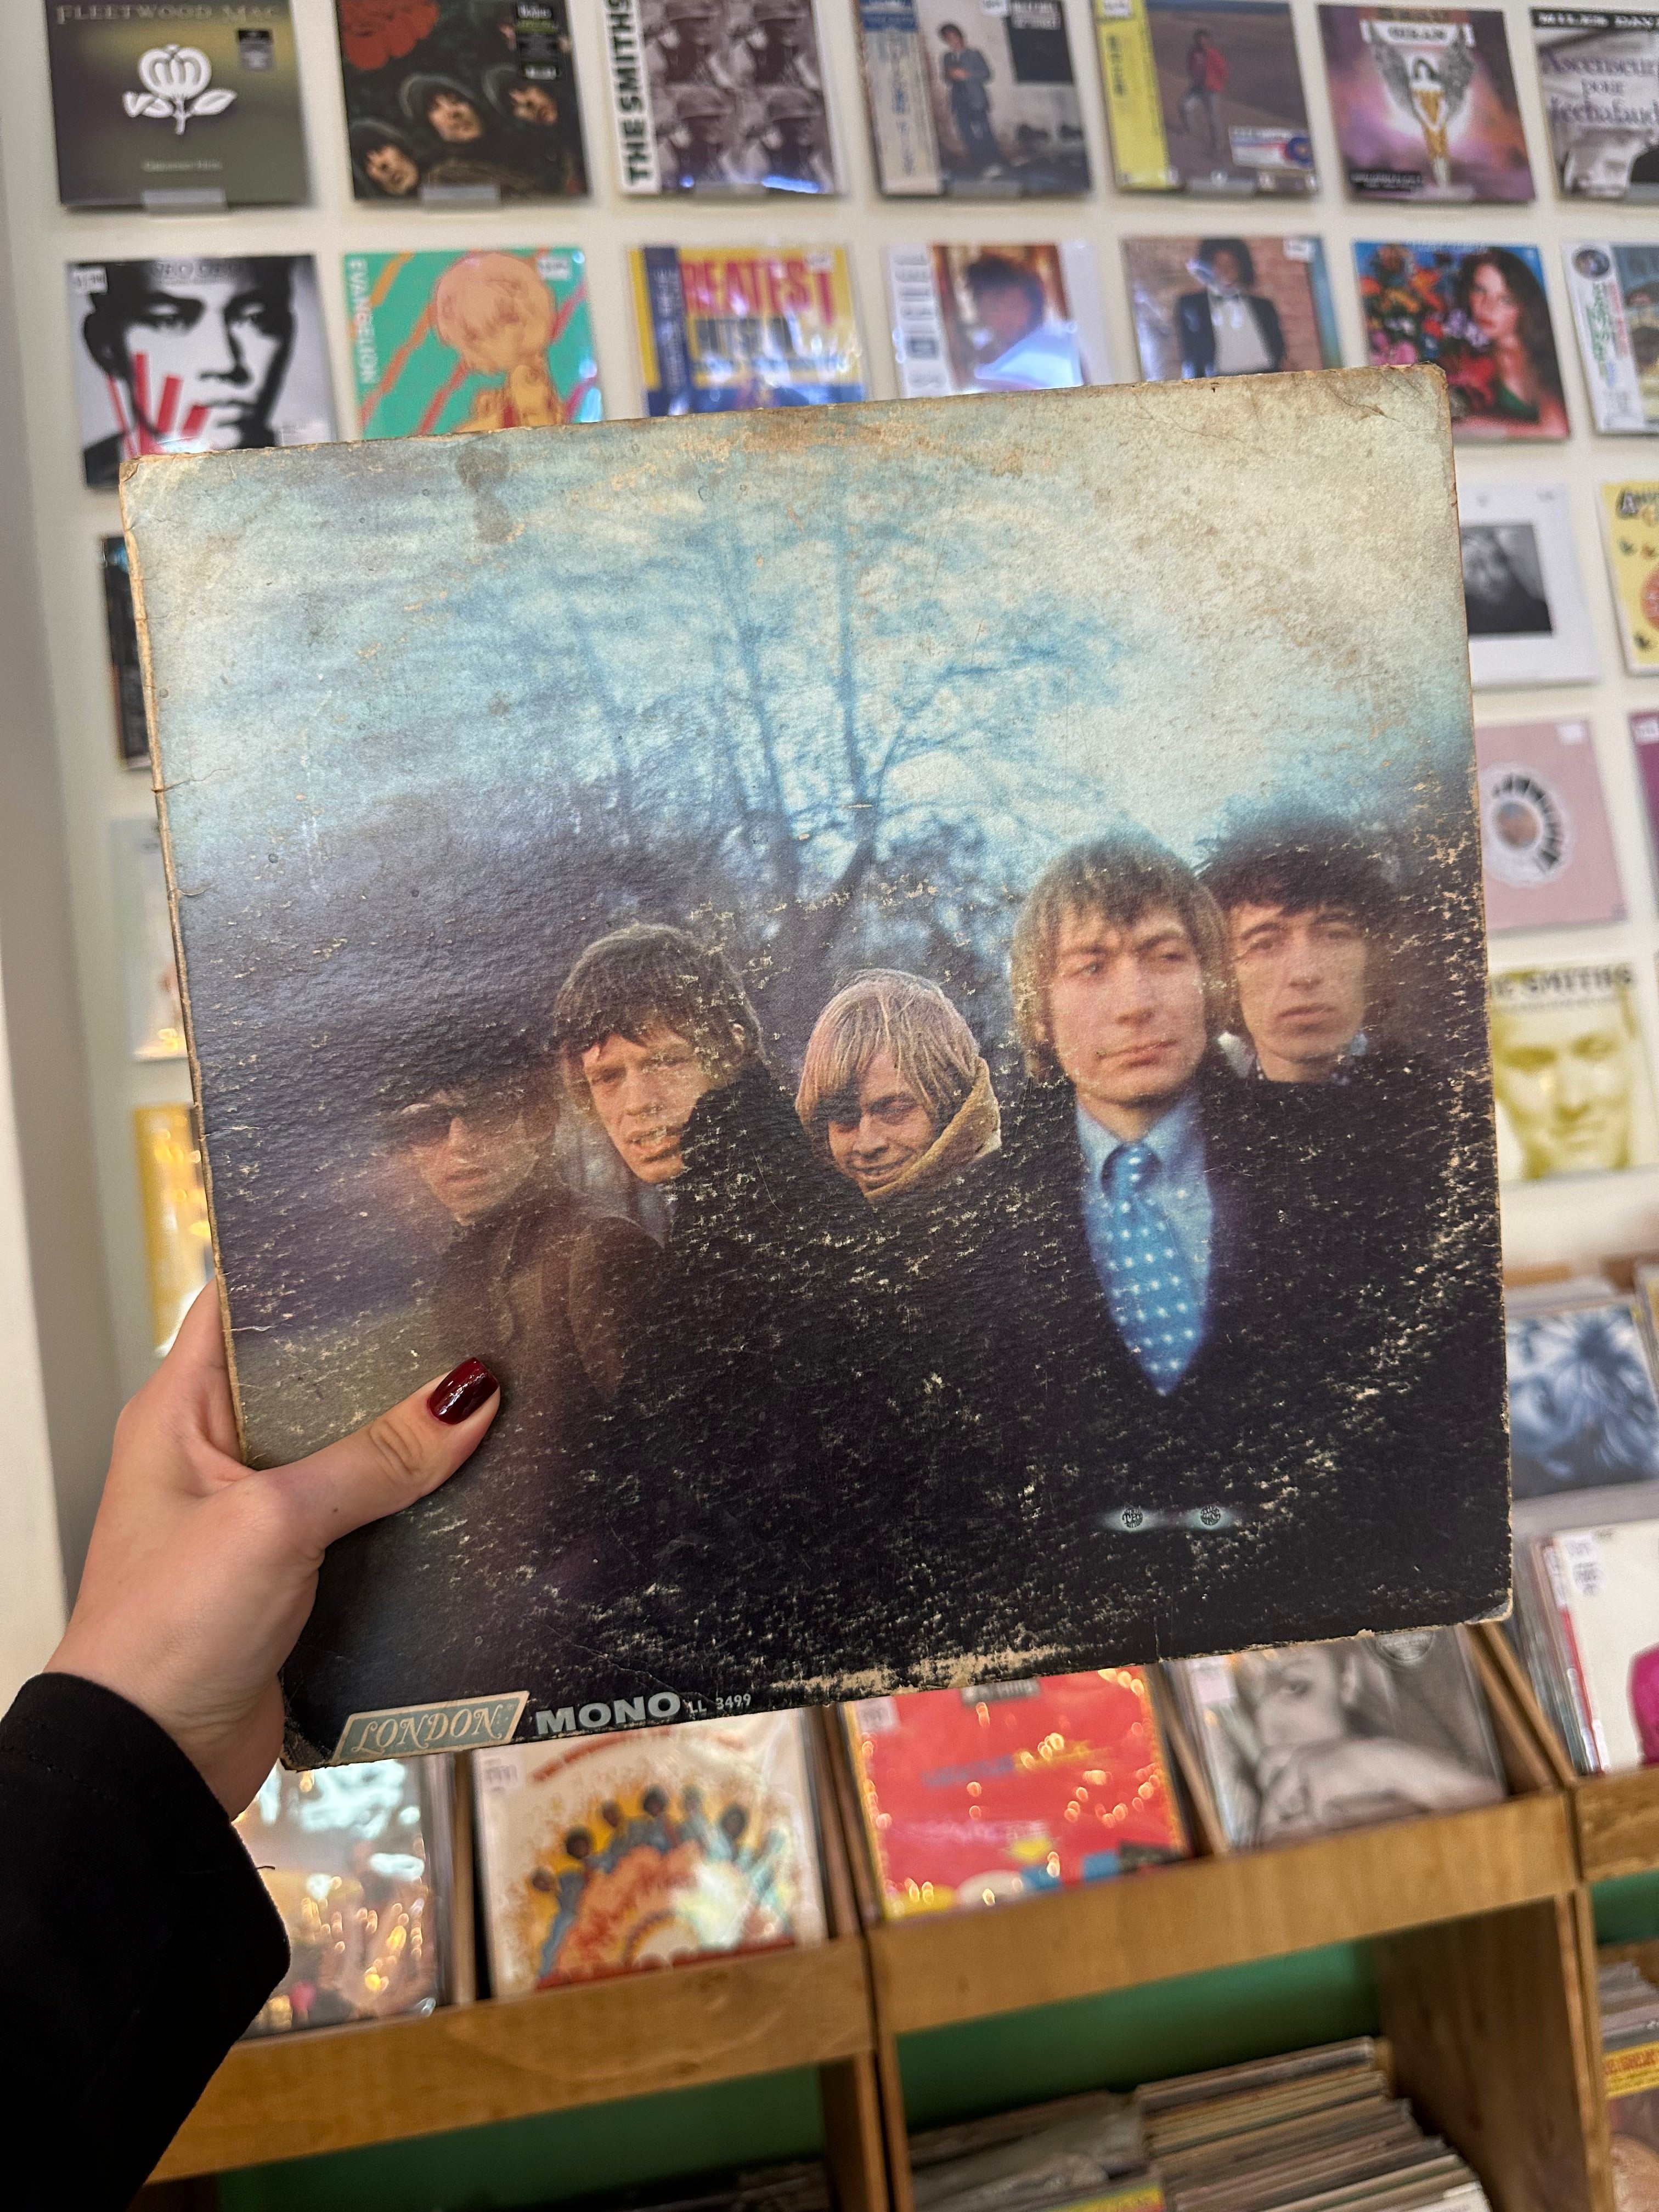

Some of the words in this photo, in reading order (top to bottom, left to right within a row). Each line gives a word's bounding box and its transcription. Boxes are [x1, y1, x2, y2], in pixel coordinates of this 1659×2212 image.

[624, 119, 652, 184] THE
[351, 1704, 503, 1754] LONDON
[535, 1691, 680, 1735] MONO
[715, 1694, 752, 1710] 3499
